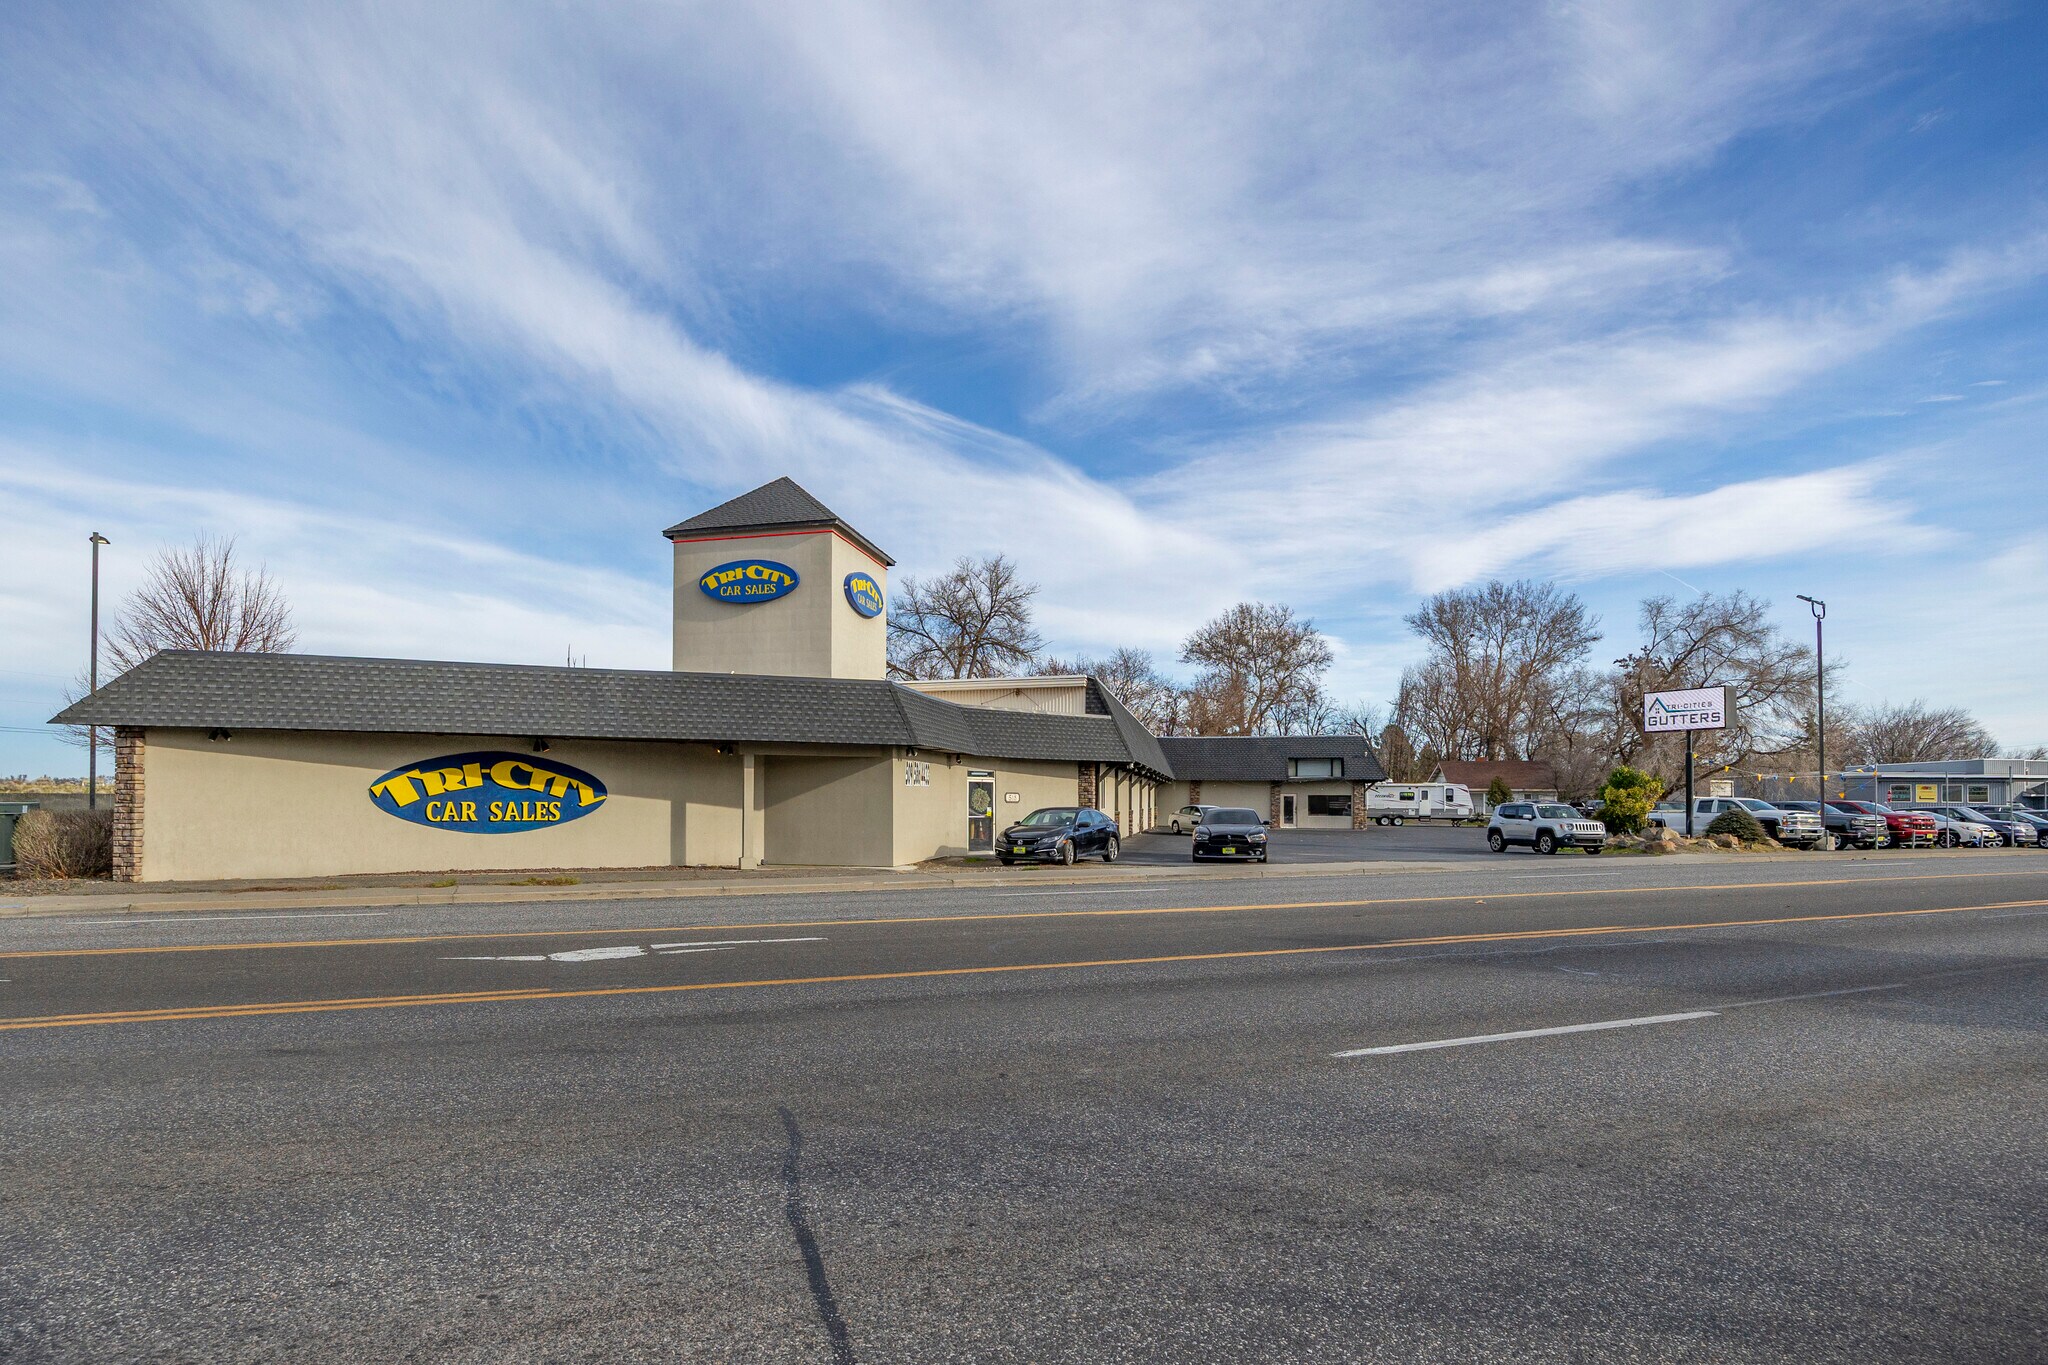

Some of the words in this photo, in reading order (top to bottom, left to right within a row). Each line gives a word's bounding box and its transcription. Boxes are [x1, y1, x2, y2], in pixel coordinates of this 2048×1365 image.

[701, 565, 795, 590] TRI-CITY
[720, 585, 741, 596] CAR
[745, 583, 776, 595] SALES
[1666, 701, 1713, 710] TRI-CITIES
[1648, 712, 1721, 726] GUTTERS
[370, 760, 607, 807] TRI-CITY
[426, 801, 478, 822] CAR
[489, 801, 562, 822] SALES
